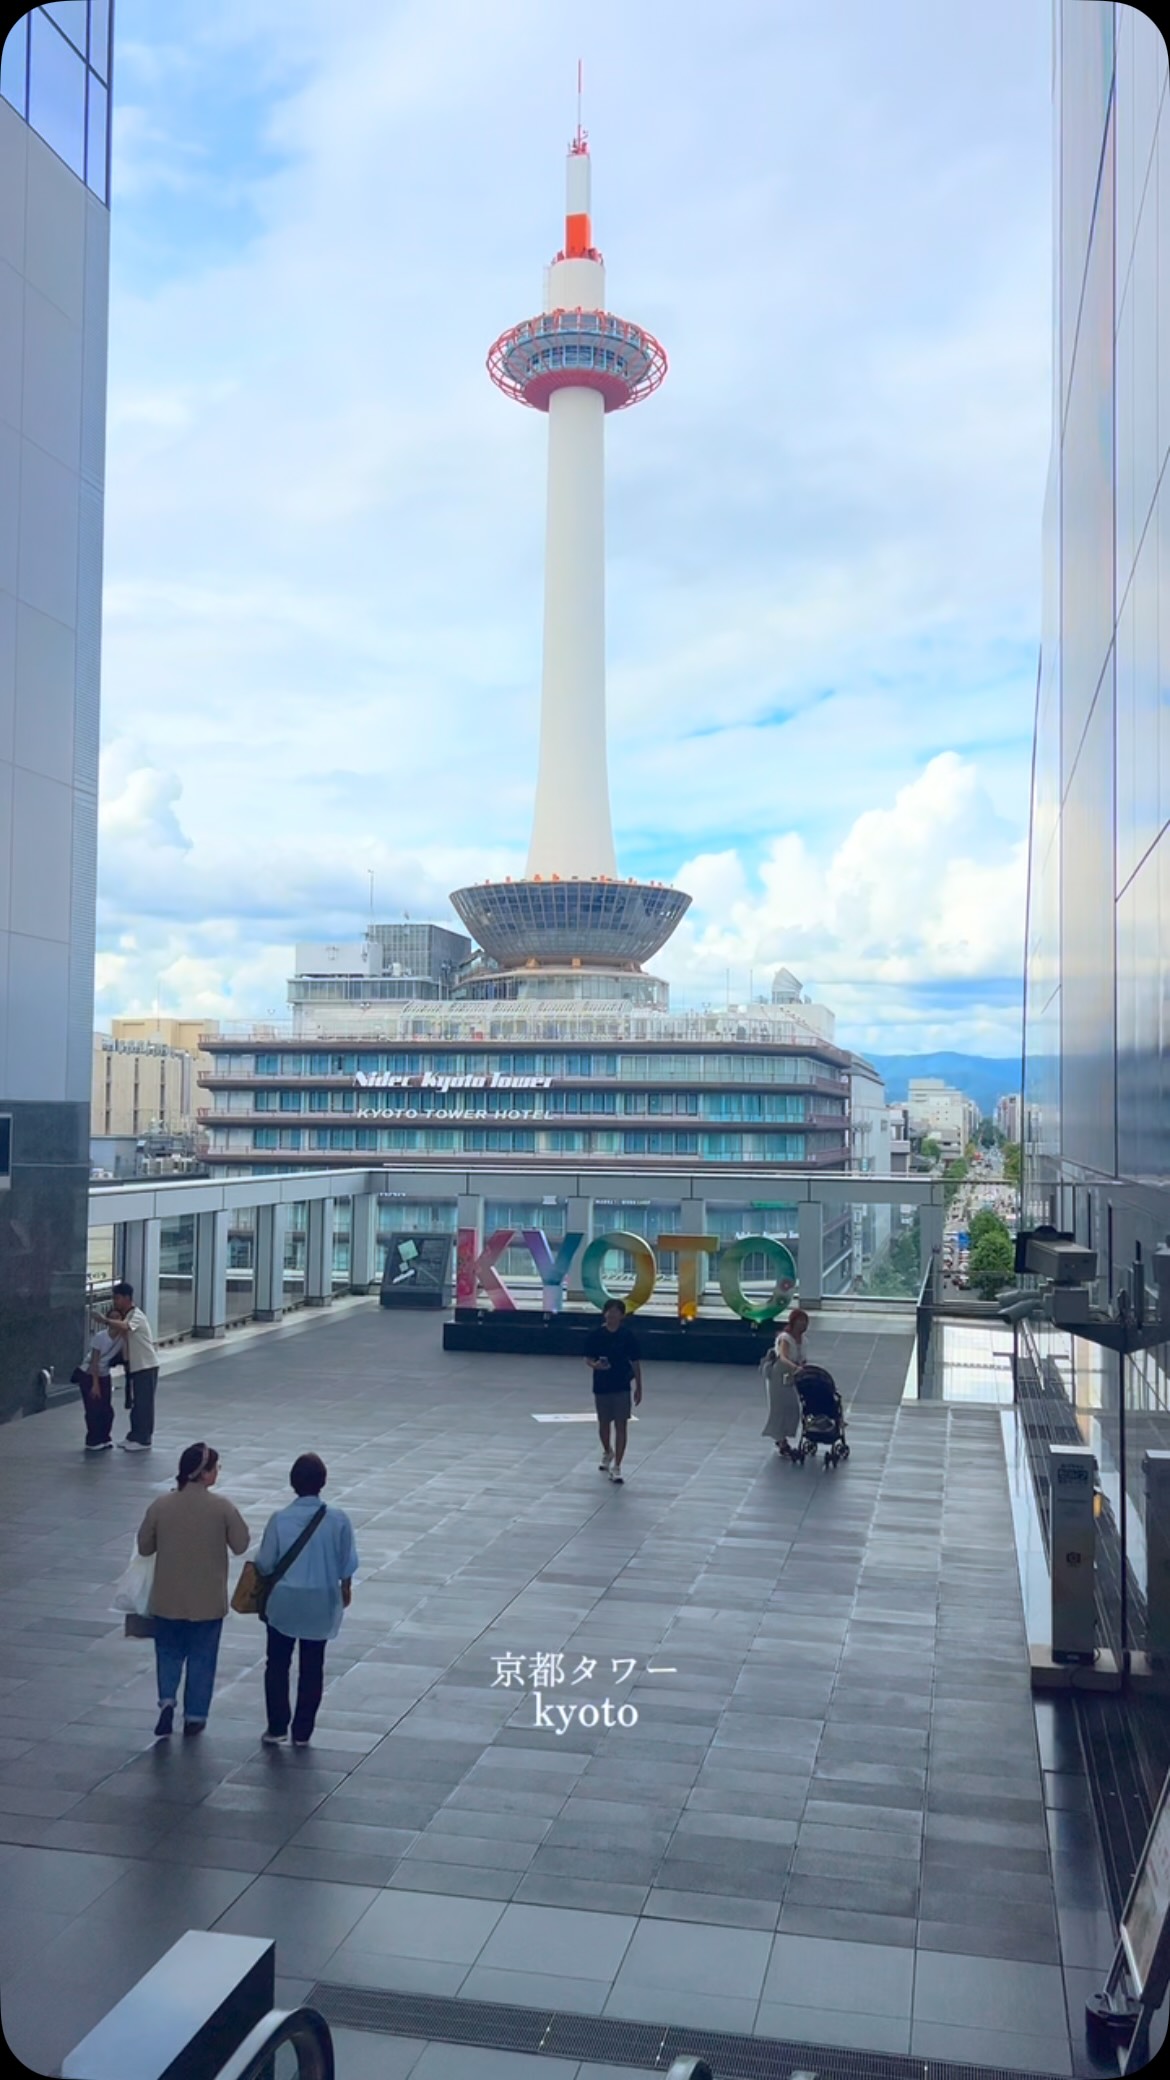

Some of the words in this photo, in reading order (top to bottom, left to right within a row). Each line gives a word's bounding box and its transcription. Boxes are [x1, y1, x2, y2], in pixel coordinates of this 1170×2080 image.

[354, 1071, 411, 1088] Nidec
[420, 1071, 487, 1093] Kyoto
[489, 1071, 553, 1088] Tower
[356, 1108, 419, 1119] KYOTO
[423, 1109, 488, 1120] TOWER
[494, 1109, 554, 1121] HOTEL
[456, 1226, 797, 1322] KYOTO
